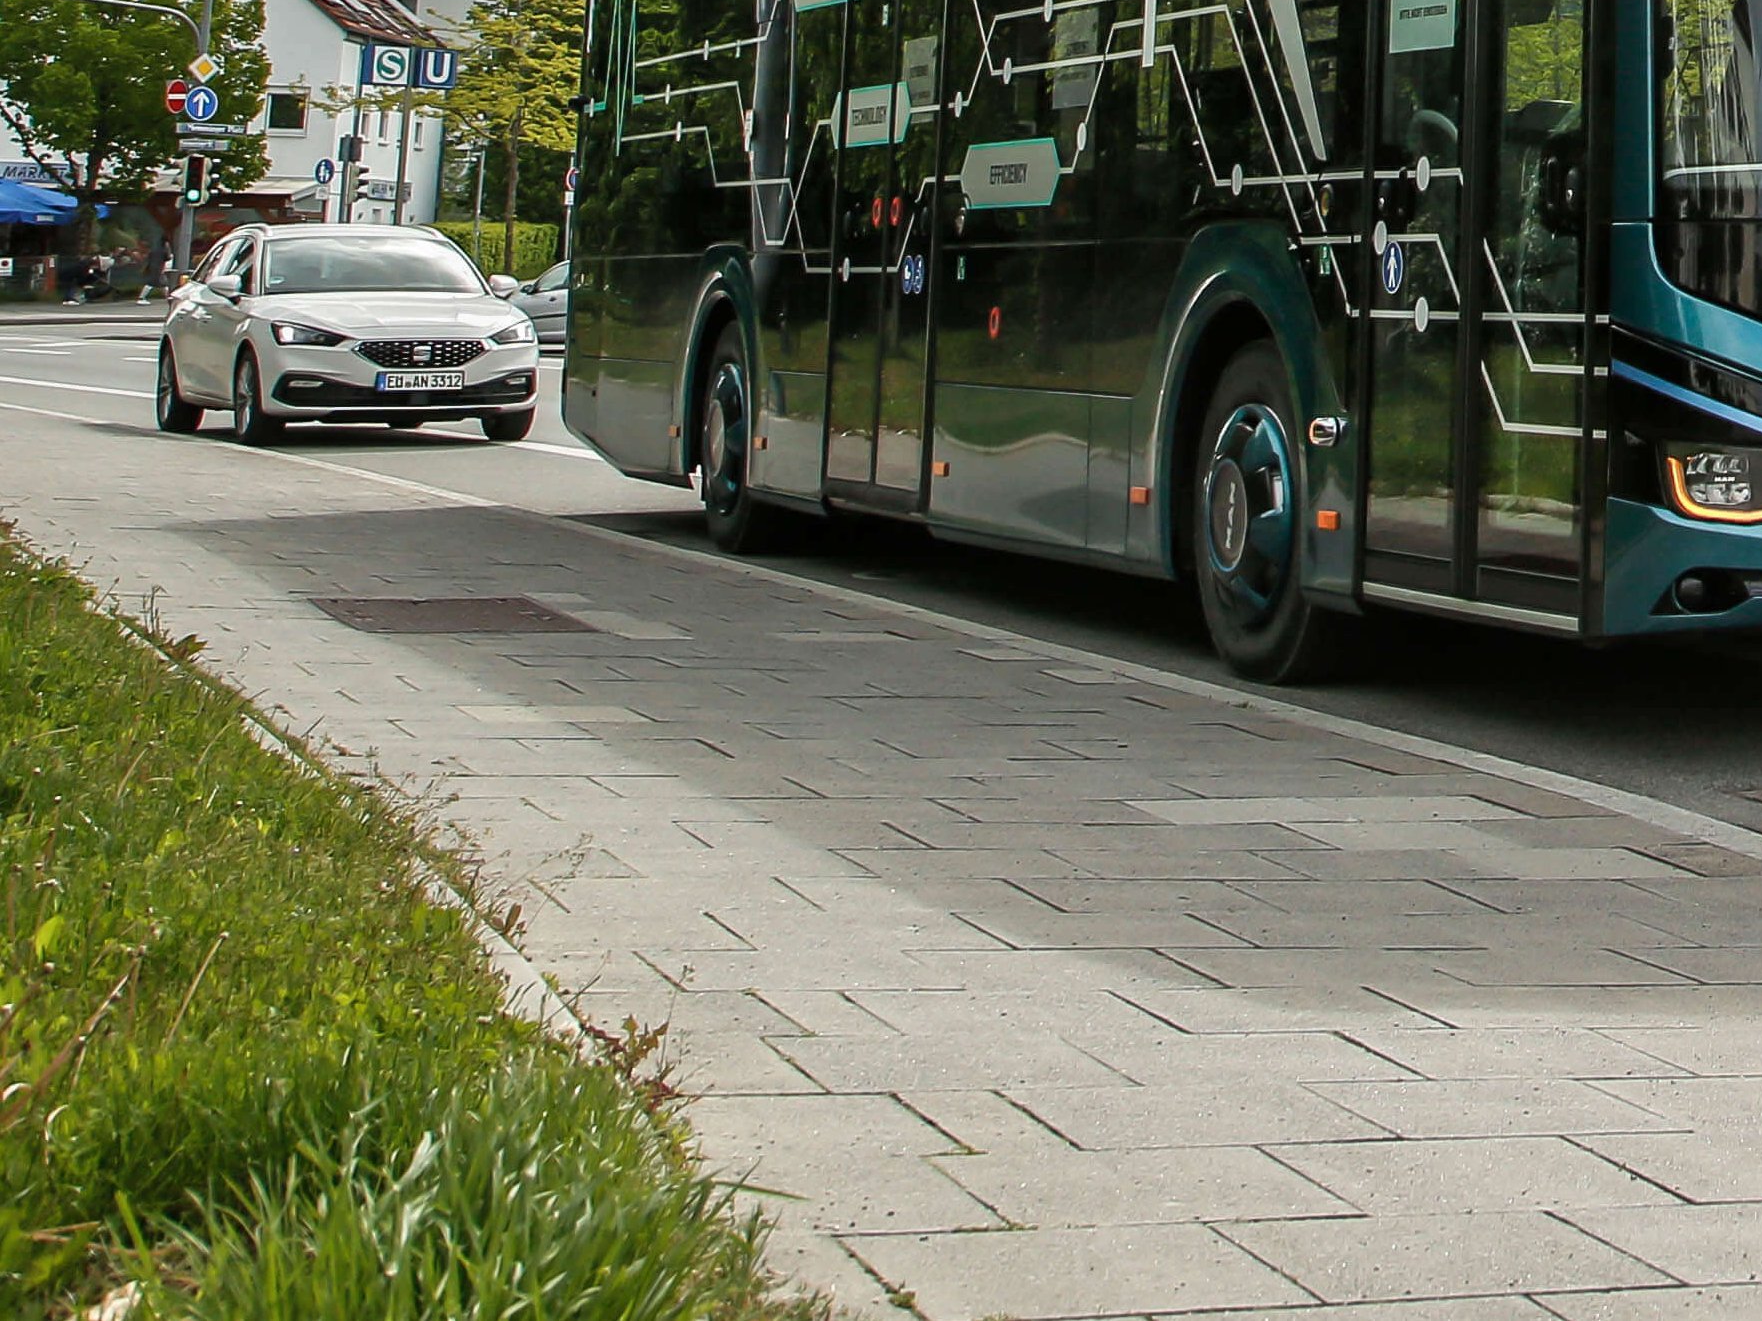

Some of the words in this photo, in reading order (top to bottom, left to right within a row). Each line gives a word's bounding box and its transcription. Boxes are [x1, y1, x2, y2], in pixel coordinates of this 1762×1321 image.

[380, 51, 402, 78] S
[426, 51, 450, 84] U
[413, 375, 429, 388] AN
[431, 374, 461, 388] 3312
